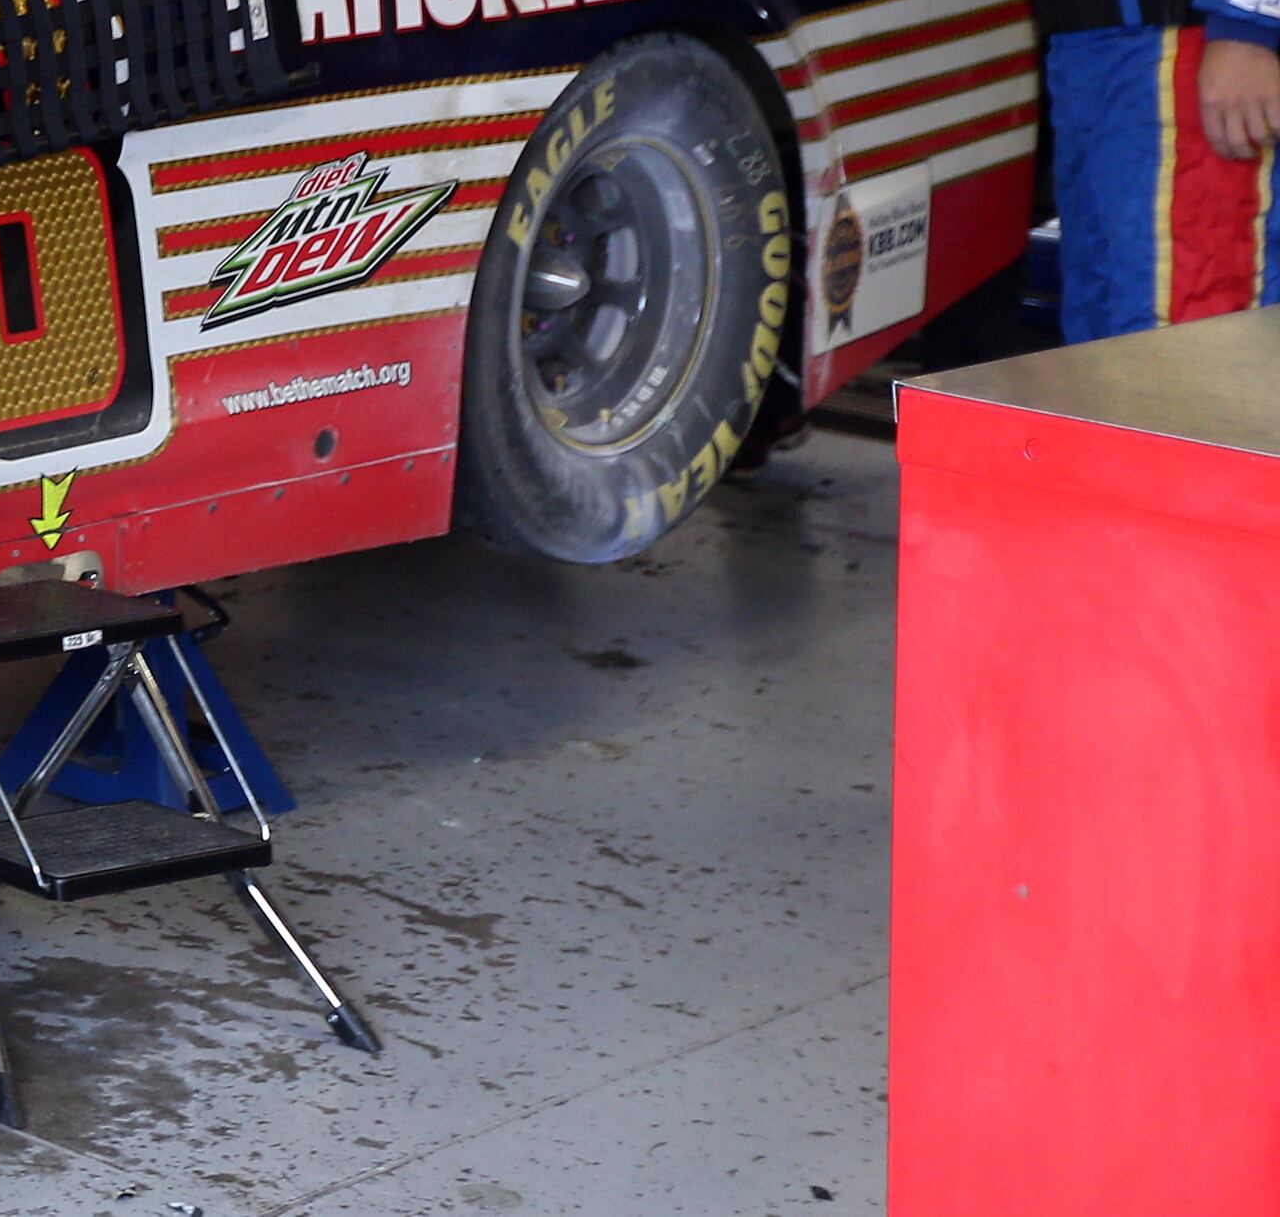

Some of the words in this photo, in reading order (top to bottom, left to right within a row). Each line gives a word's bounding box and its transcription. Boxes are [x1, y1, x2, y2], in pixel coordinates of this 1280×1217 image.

[296, 161, 356, 199] diet
[506, 72, 616, 250] EAGLE
[221, 362, 412, 416] www.bethematch.org
